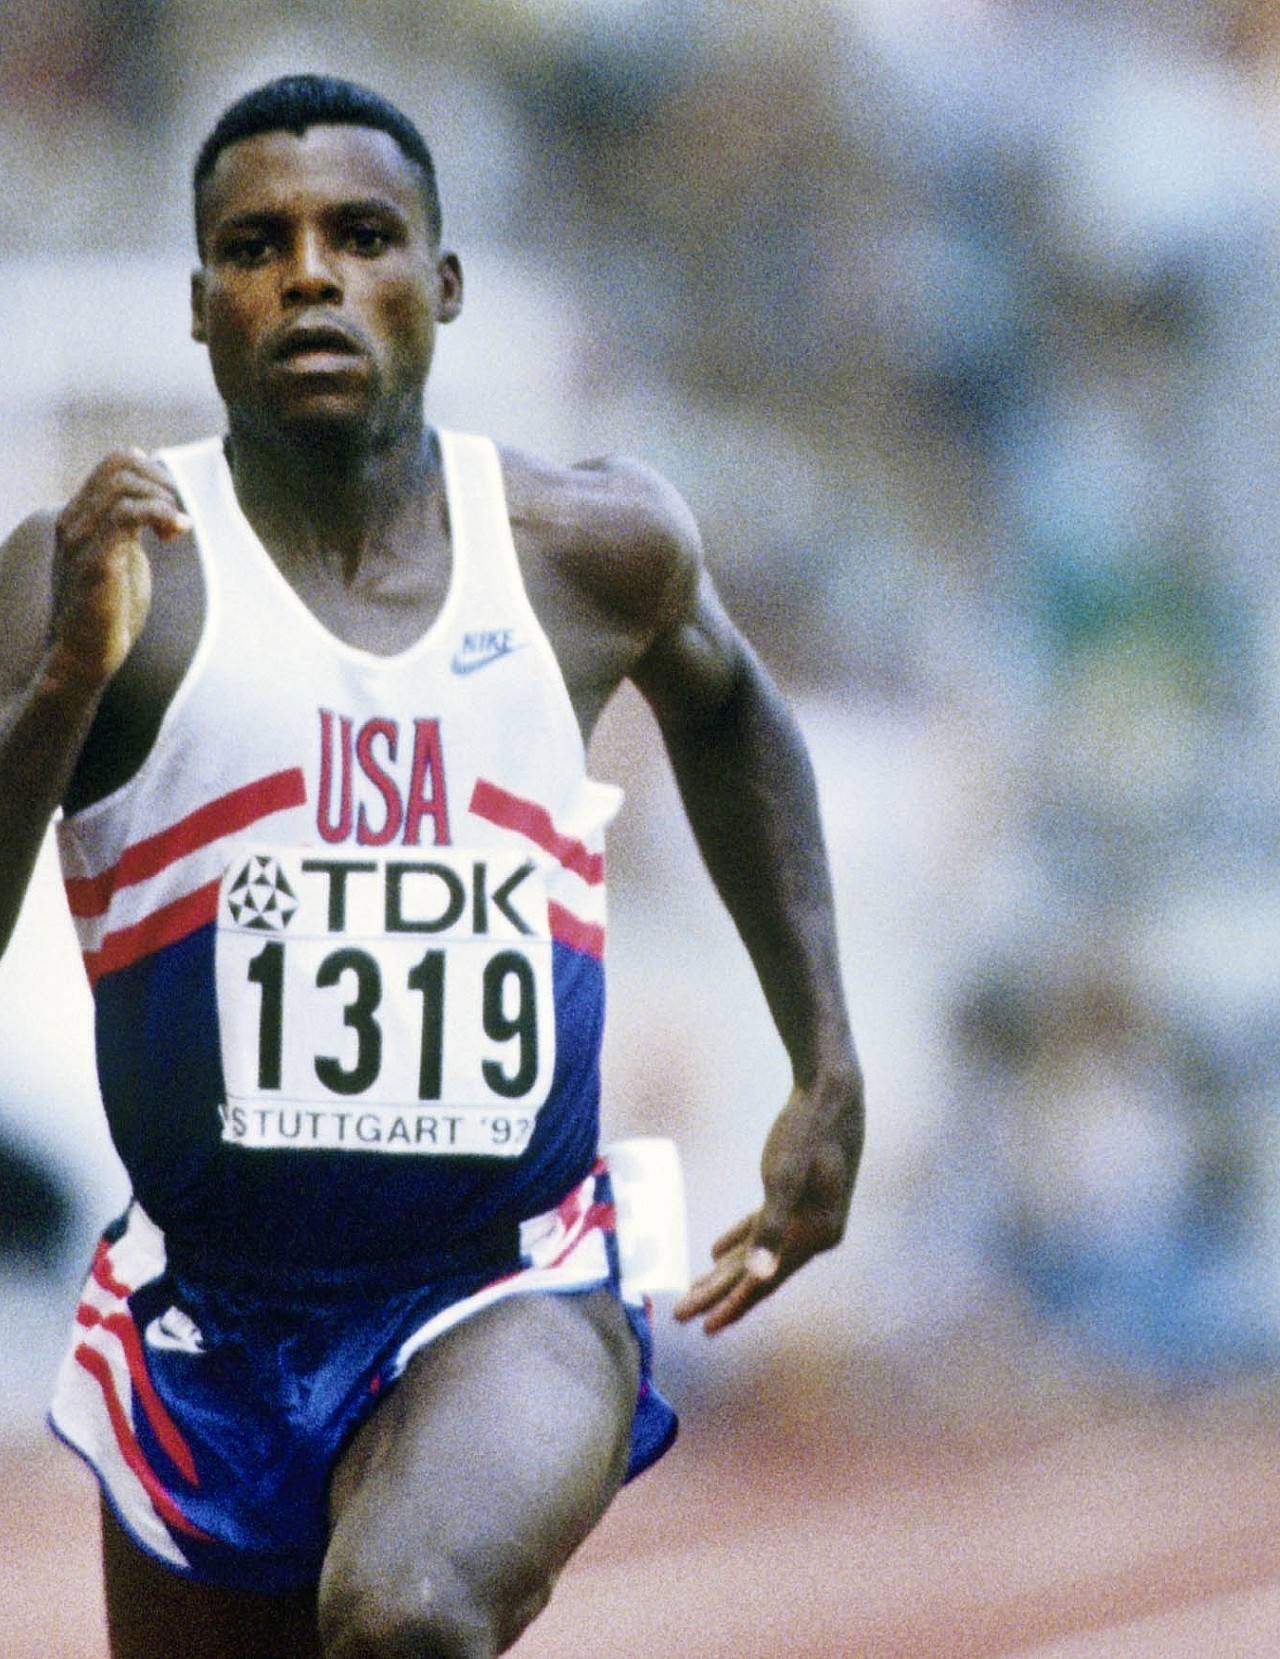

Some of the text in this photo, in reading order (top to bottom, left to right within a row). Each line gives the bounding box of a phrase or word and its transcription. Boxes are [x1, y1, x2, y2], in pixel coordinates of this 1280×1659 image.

[462, 629, 514, 653] NIKE
[317, 709, 452, 846] USA
[301, 859, 535, 935] TDK
[246, 940, 539, 1100] 1319
[231, 1106, 464, 1144] STUTTGART
